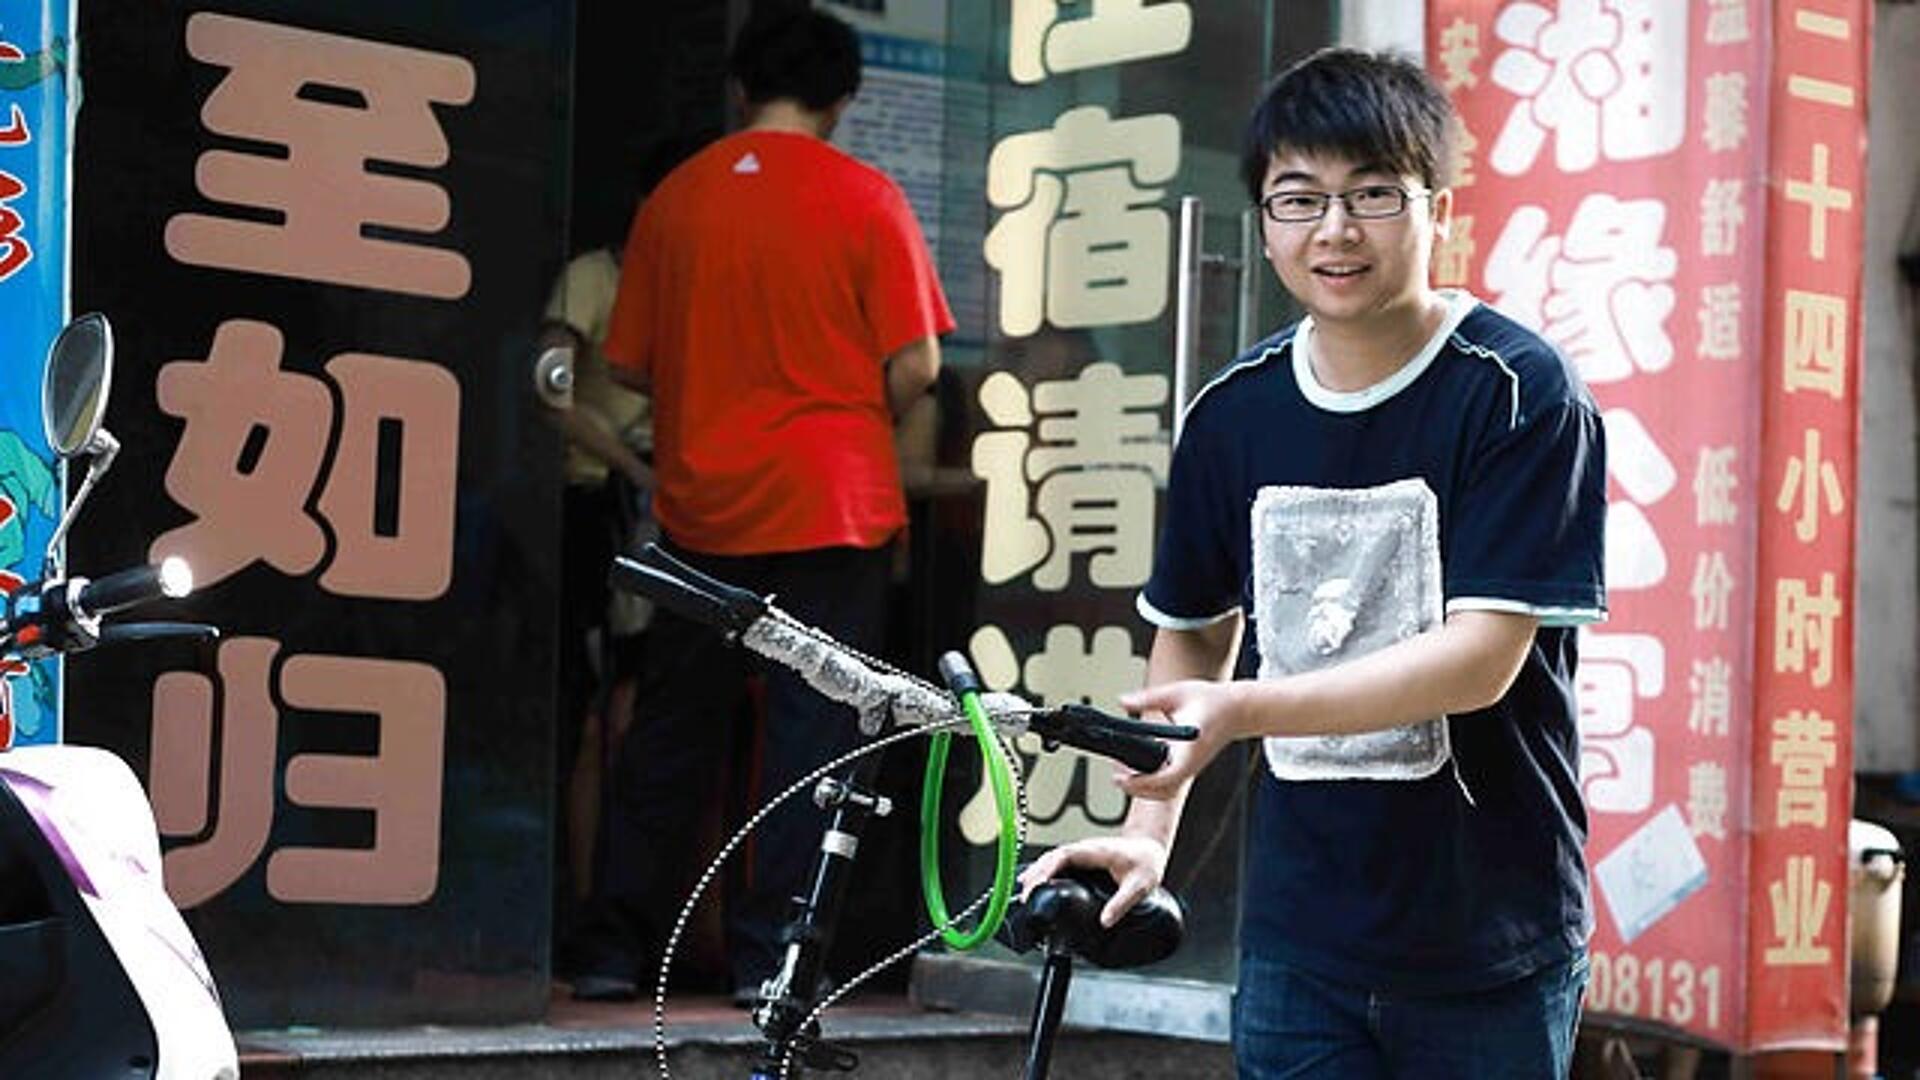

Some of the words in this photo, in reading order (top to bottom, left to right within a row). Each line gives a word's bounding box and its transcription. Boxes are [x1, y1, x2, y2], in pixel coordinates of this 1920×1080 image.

[149, 11, 476, 910] 至如归
[1688, 446, 1740, 841] 低价消费
[1764, 10, 1855, 967] 二十四小时营业
[1589, 952, 1721, 1030] 08131
